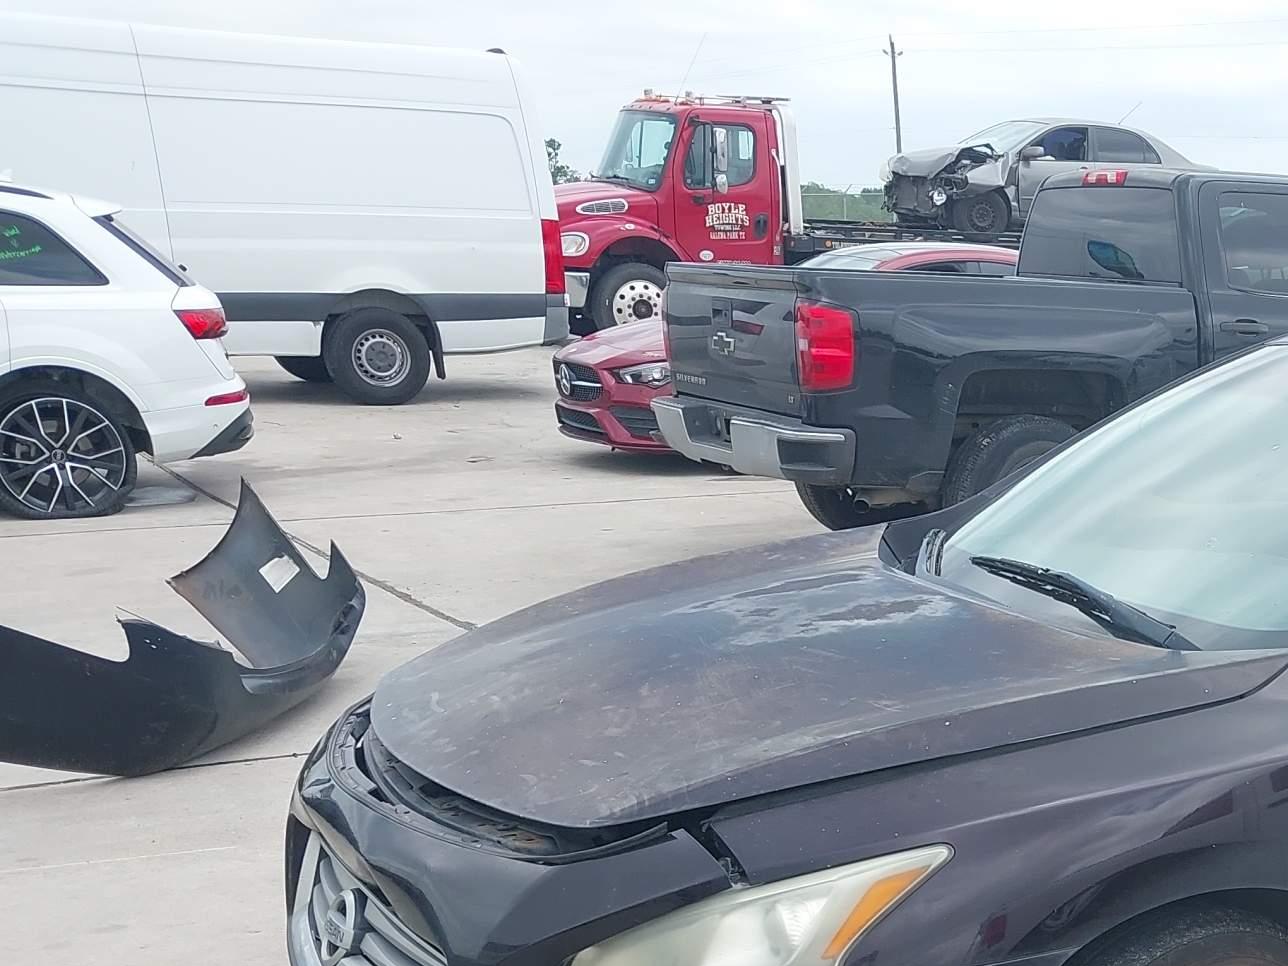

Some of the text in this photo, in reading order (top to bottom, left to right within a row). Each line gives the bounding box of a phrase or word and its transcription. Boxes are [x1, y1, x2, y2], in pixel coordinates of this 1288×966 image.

[707, 202, 746, 215] BOYLE
[705, 213, 750, 227] HEIGHTS
[727, 231, 738, 240] PARK
[675, 373, 706, 385] SILVERADO
